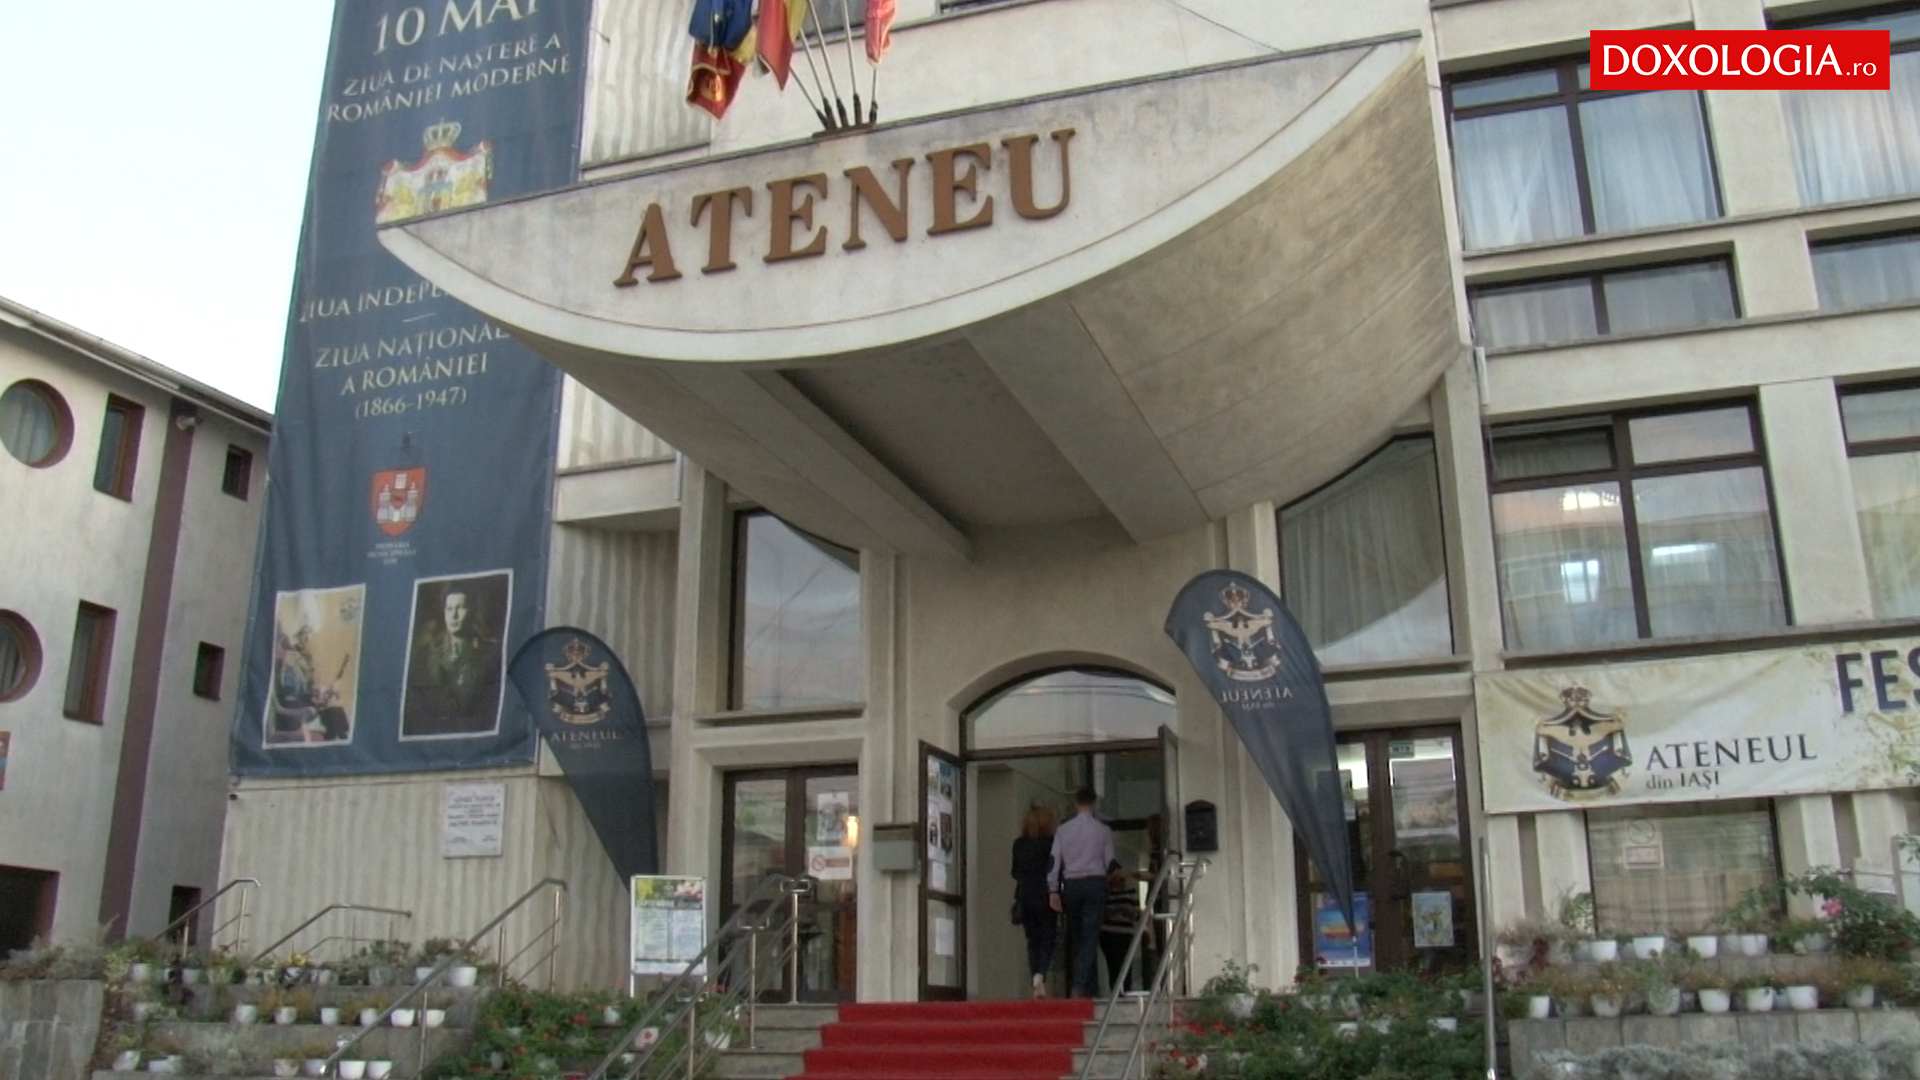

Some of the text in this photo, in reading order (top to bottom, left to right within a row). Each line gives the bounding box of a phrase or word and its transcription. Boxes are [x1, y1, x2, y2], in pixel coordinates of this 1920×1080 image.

[372, 7, 426, 56] 10
[343, 69, 395, 96] ZIUA
[403, 65, 432, 84] DE
[544, 32, 562, 49] A
[327, 54, 571, 123] ROMÂNIEI MODERNE
[612, 127, 1077, 287] ATENEU
[357, 280, 450, 312] INDEPE
[315, 342, 370, 368] ZIUA
[341, 352, 489, 395] A ROMÂNIEI
[354, 386, 468, 420] (1866-1947)
[551, 730, 619, 742] ATENEUL
[1645, 734, 1818, 771] ATENEUL
[1645, 774, 1673, 790] din
